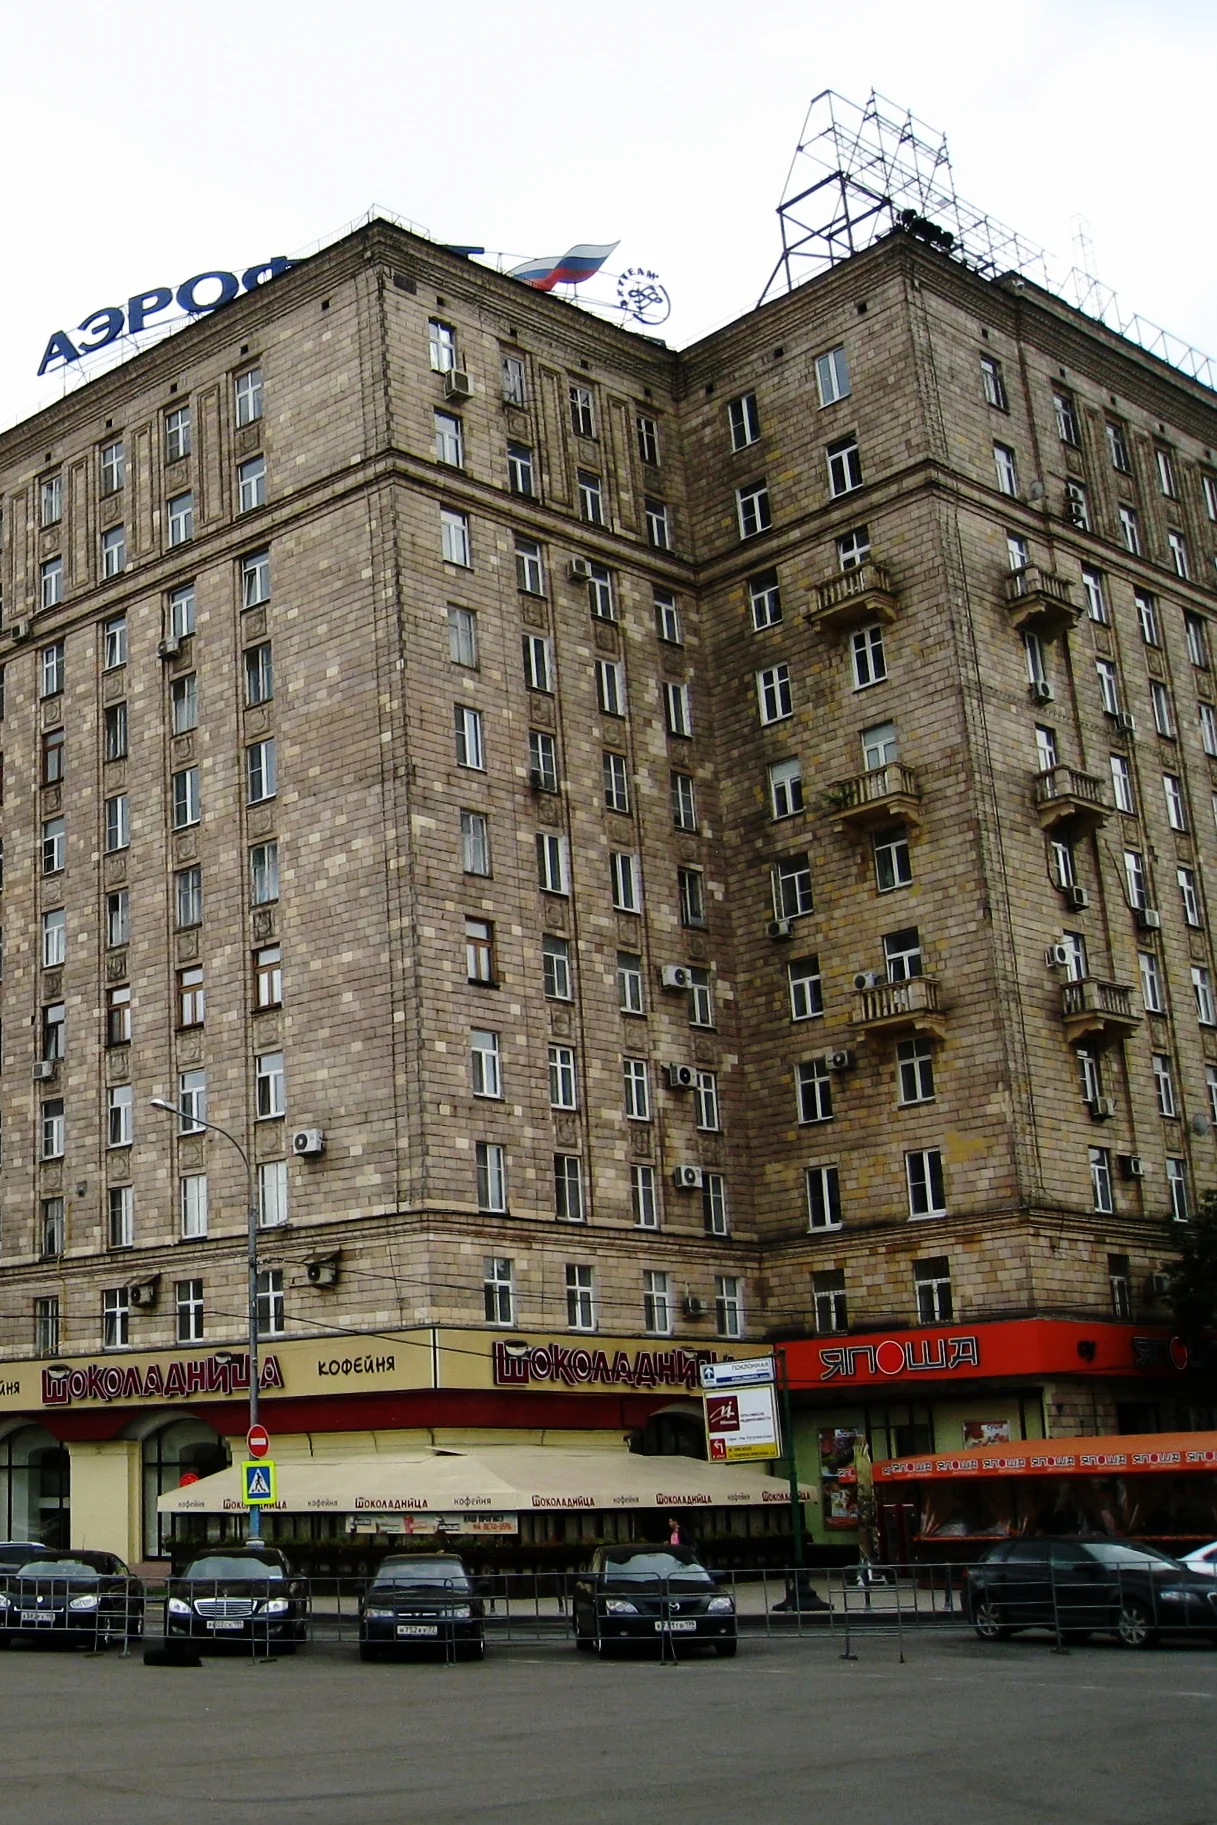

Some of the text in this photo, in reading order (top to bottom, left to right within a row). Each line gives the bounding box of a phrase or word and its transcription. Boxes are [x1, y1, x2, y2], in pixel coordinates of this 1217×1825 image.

[318, 1354, 396, 1376] КОФЕЙНЯ
[492, 1340, 734, 1390] ШОКОЛАДНИ
[819, 1336, 979, 1381] ЯПОША
[41, 1353, 285, 1406] ШОКОЛАДНИЦА
[983, 1457, 1026, 1469] ЯПОША
[1030, 1455, 1076, 1467] ЯПОША
[1080, 1453, 1127, 1466] ЯПОША
[1132, 1452, 1180, 1464] ЯПОША
[1186, 1450, 1217, 1463] ЯПО
[223, 1499, 287, 1510] ШОКОДНИЦА
[355, 1497, 429, 1510] ШОКОЛАДНИЦА
[453, 1496, 492, 1507] кофейня
[532, 1495, 595, 1507] ШОКОЛАДНИЦА
[656, 1493, 713, 1505] ШОКОЛАДНИЦА
